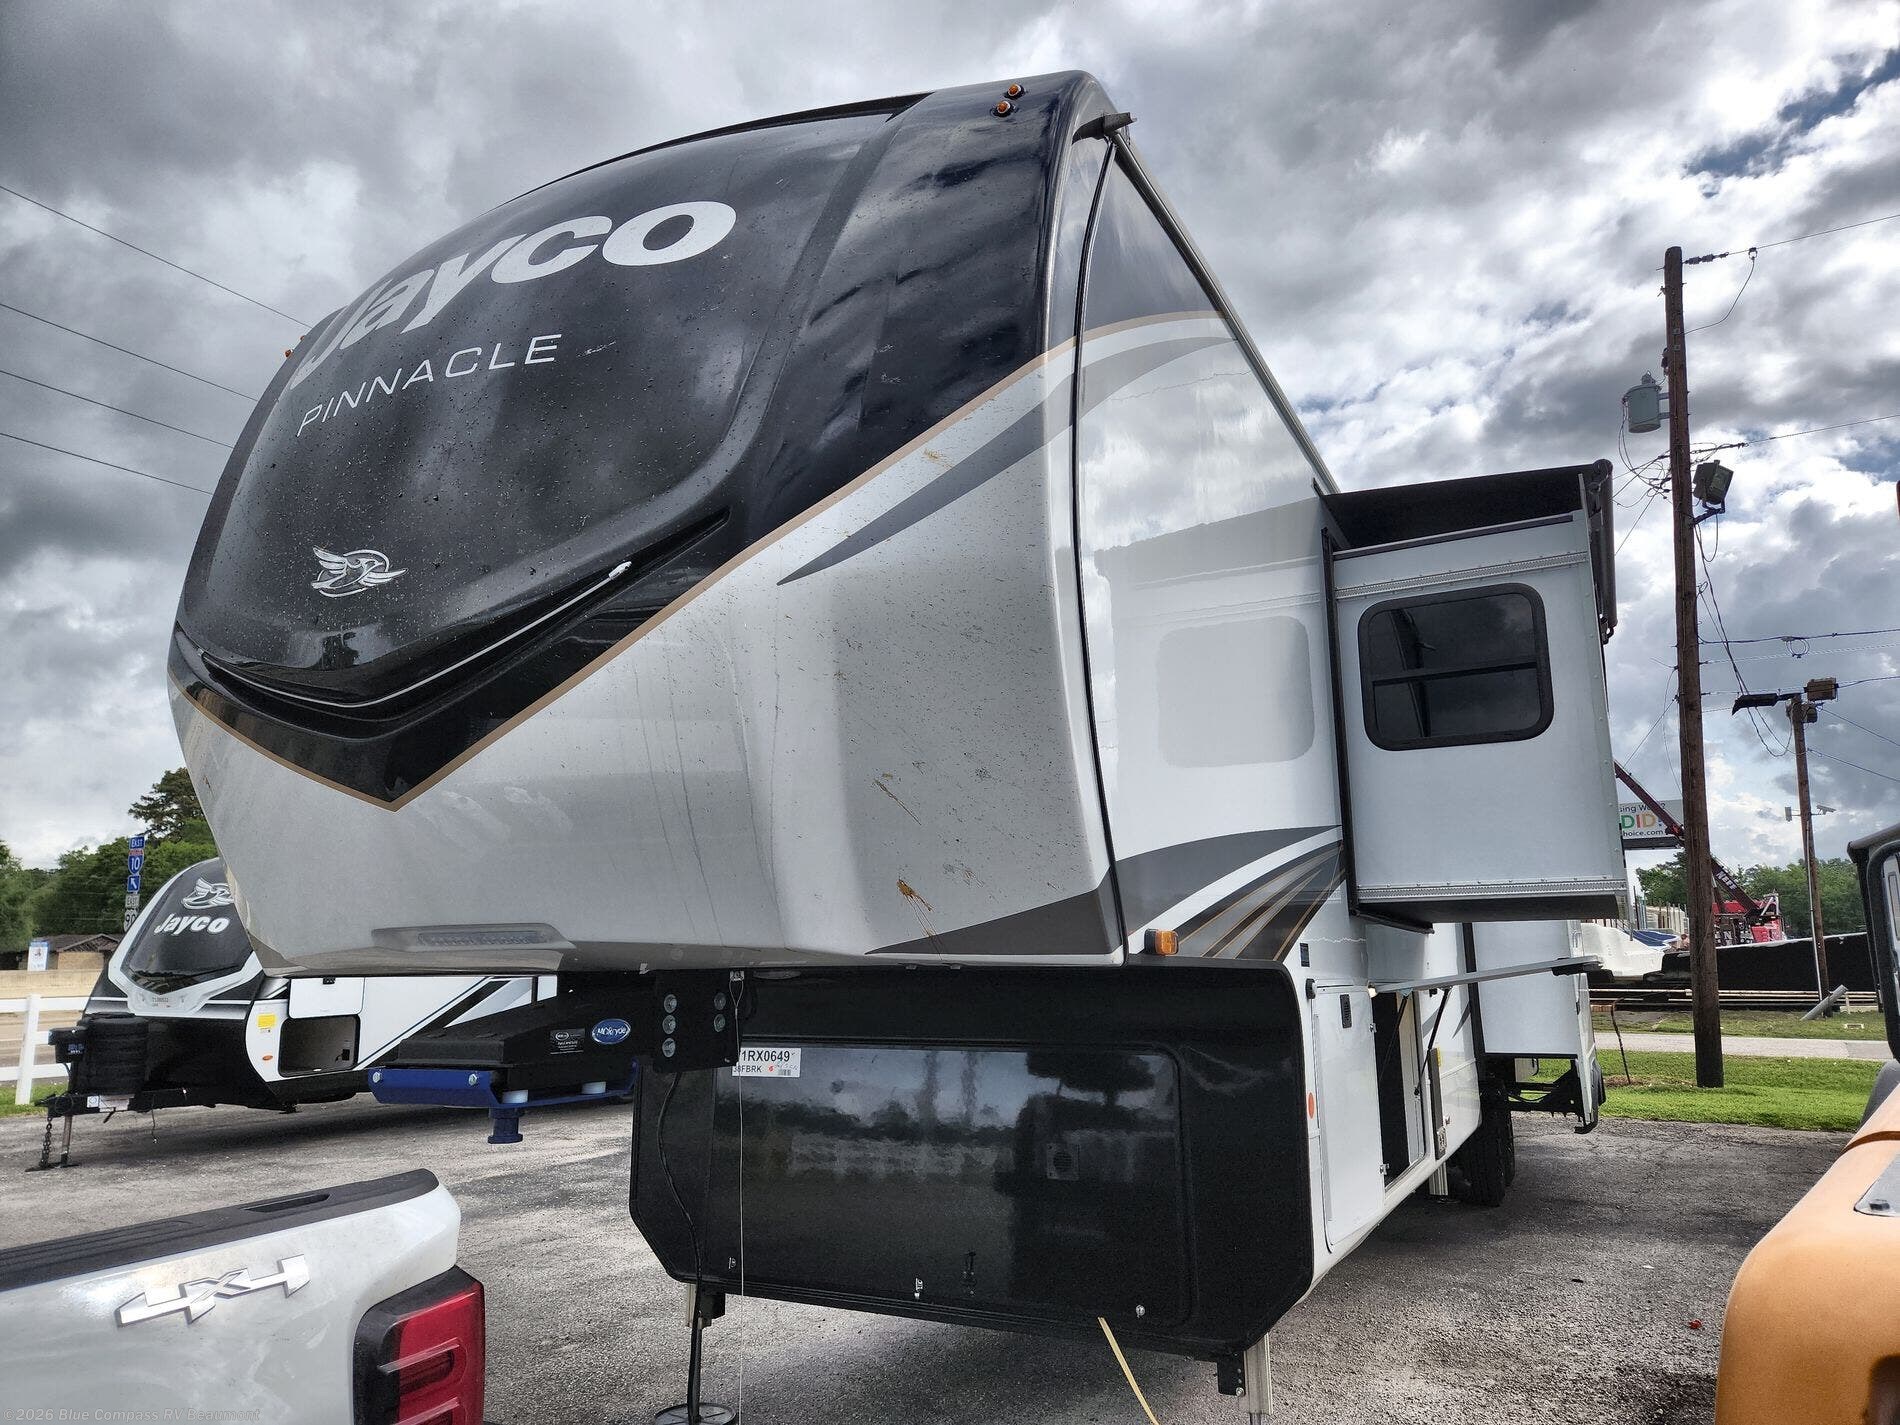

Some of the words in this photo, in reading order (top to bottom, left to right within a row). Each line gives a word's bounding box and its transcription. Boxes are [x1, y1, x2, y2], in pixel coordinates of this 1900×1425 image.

[290, 201, 737, 391] Jayco
[297, 334, 562, 437] PINNACLE
[131, 839, 143, 848] EAST
[131, 857, 141, 871] 10
[154, 913, 230, 935] Jayco
